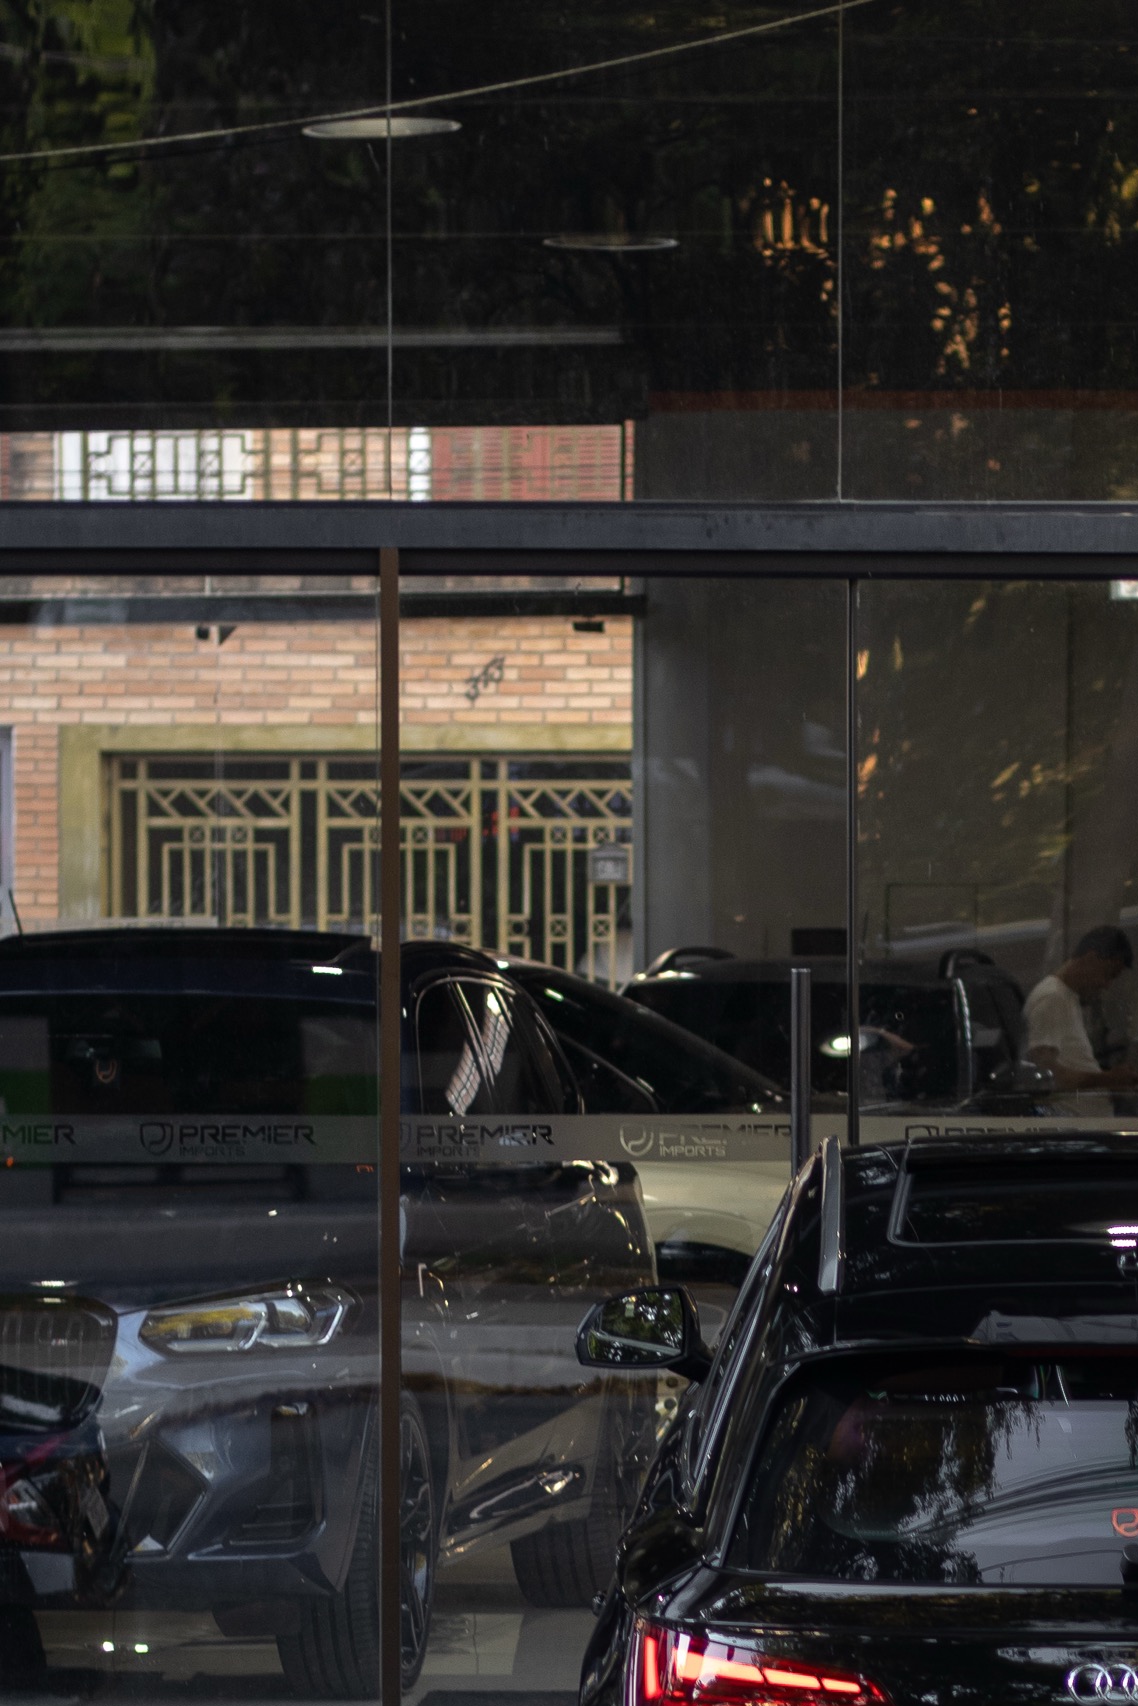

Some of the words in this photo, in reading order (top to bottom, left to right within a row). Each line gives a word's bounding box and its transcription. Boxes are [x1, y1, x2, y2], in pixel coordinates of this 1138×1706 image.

[1, 1125, 76, 1145] MIER
[179, 1125, 316, 1146] PREMIER
[417, 1124, 554, 1145] PREMIER
[179, 1147, 246, 1157] IMPORTS
[659, 1145, 726, 1157] IMPORTS
